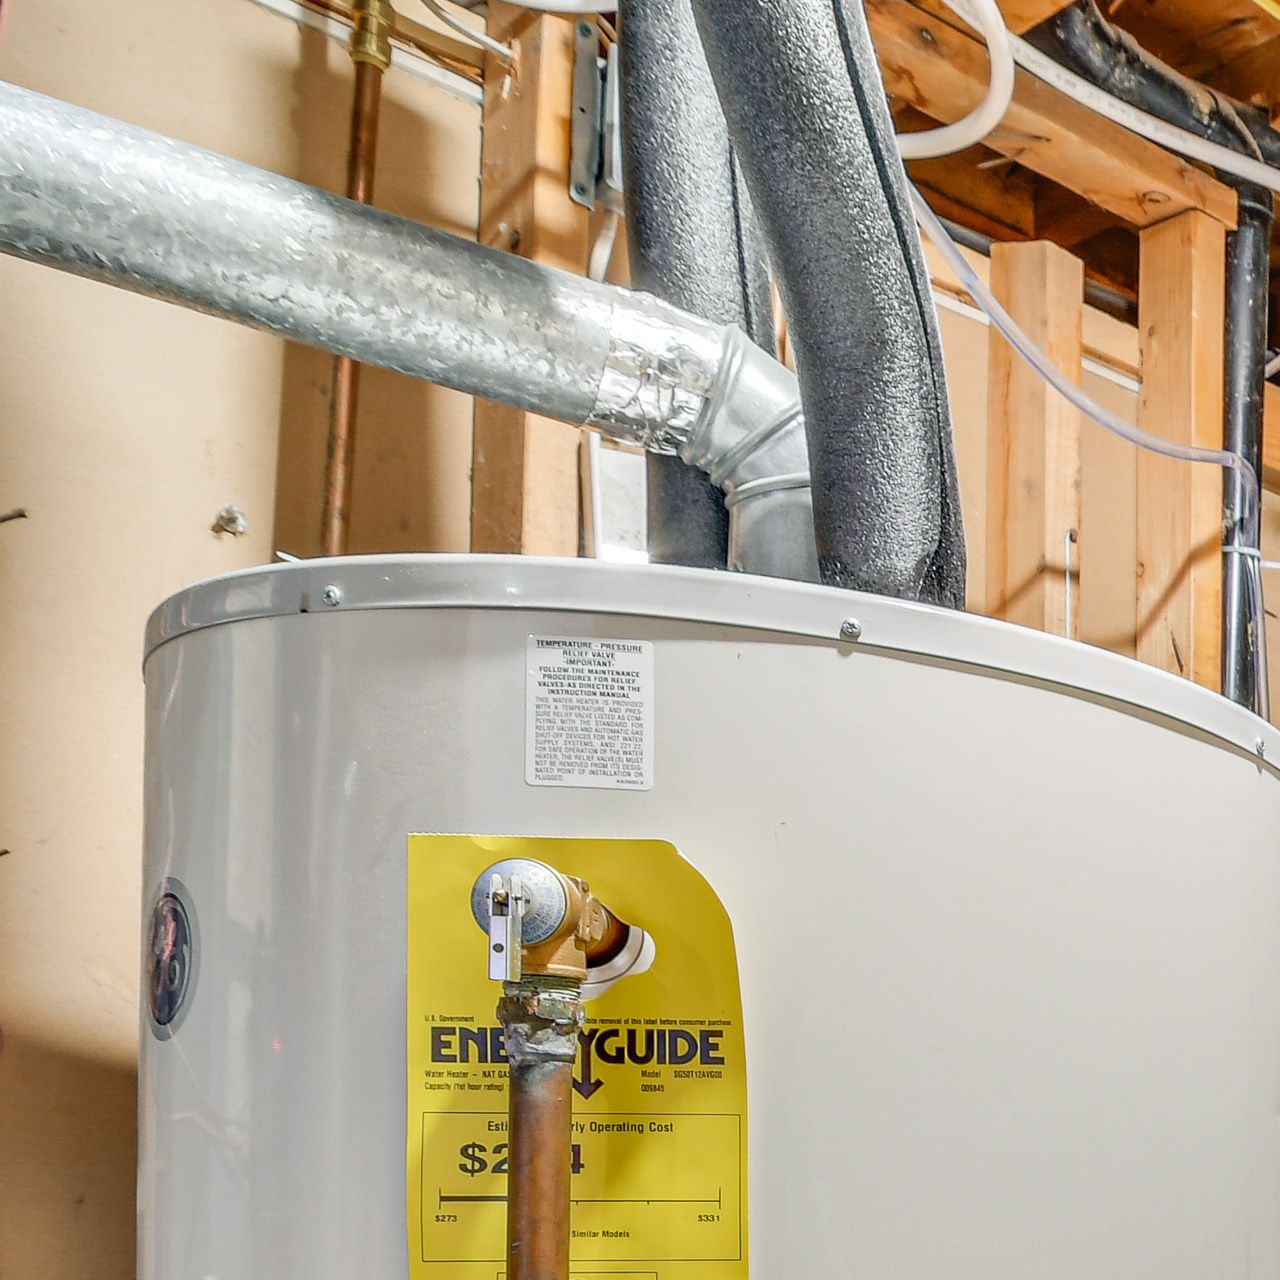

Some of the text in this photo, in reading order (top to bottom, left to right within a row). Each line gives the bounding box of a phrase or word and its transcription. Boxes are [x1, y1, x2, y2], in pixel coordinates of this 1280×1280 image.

[536, 639, 642, 652] TEMPERATURE PRESSURE
[592, 651, 615, 659] VALVE
[587, 669, 640, 678] MAINTENANCE
[439, 1015, 474, 1023] Government
[430, 1026, 725, 1065] ENEYGUIDE
[425, 1070, 444, 1078] Water
[641, 1070, 661, 1078] Model
[425, 1082, 451, 1091] Capacity
[590, 1122, 644, 1134] Operating
[649, 1122, 673, 1132] Cost
[434, 1214, 720, 1223] $273 $331
